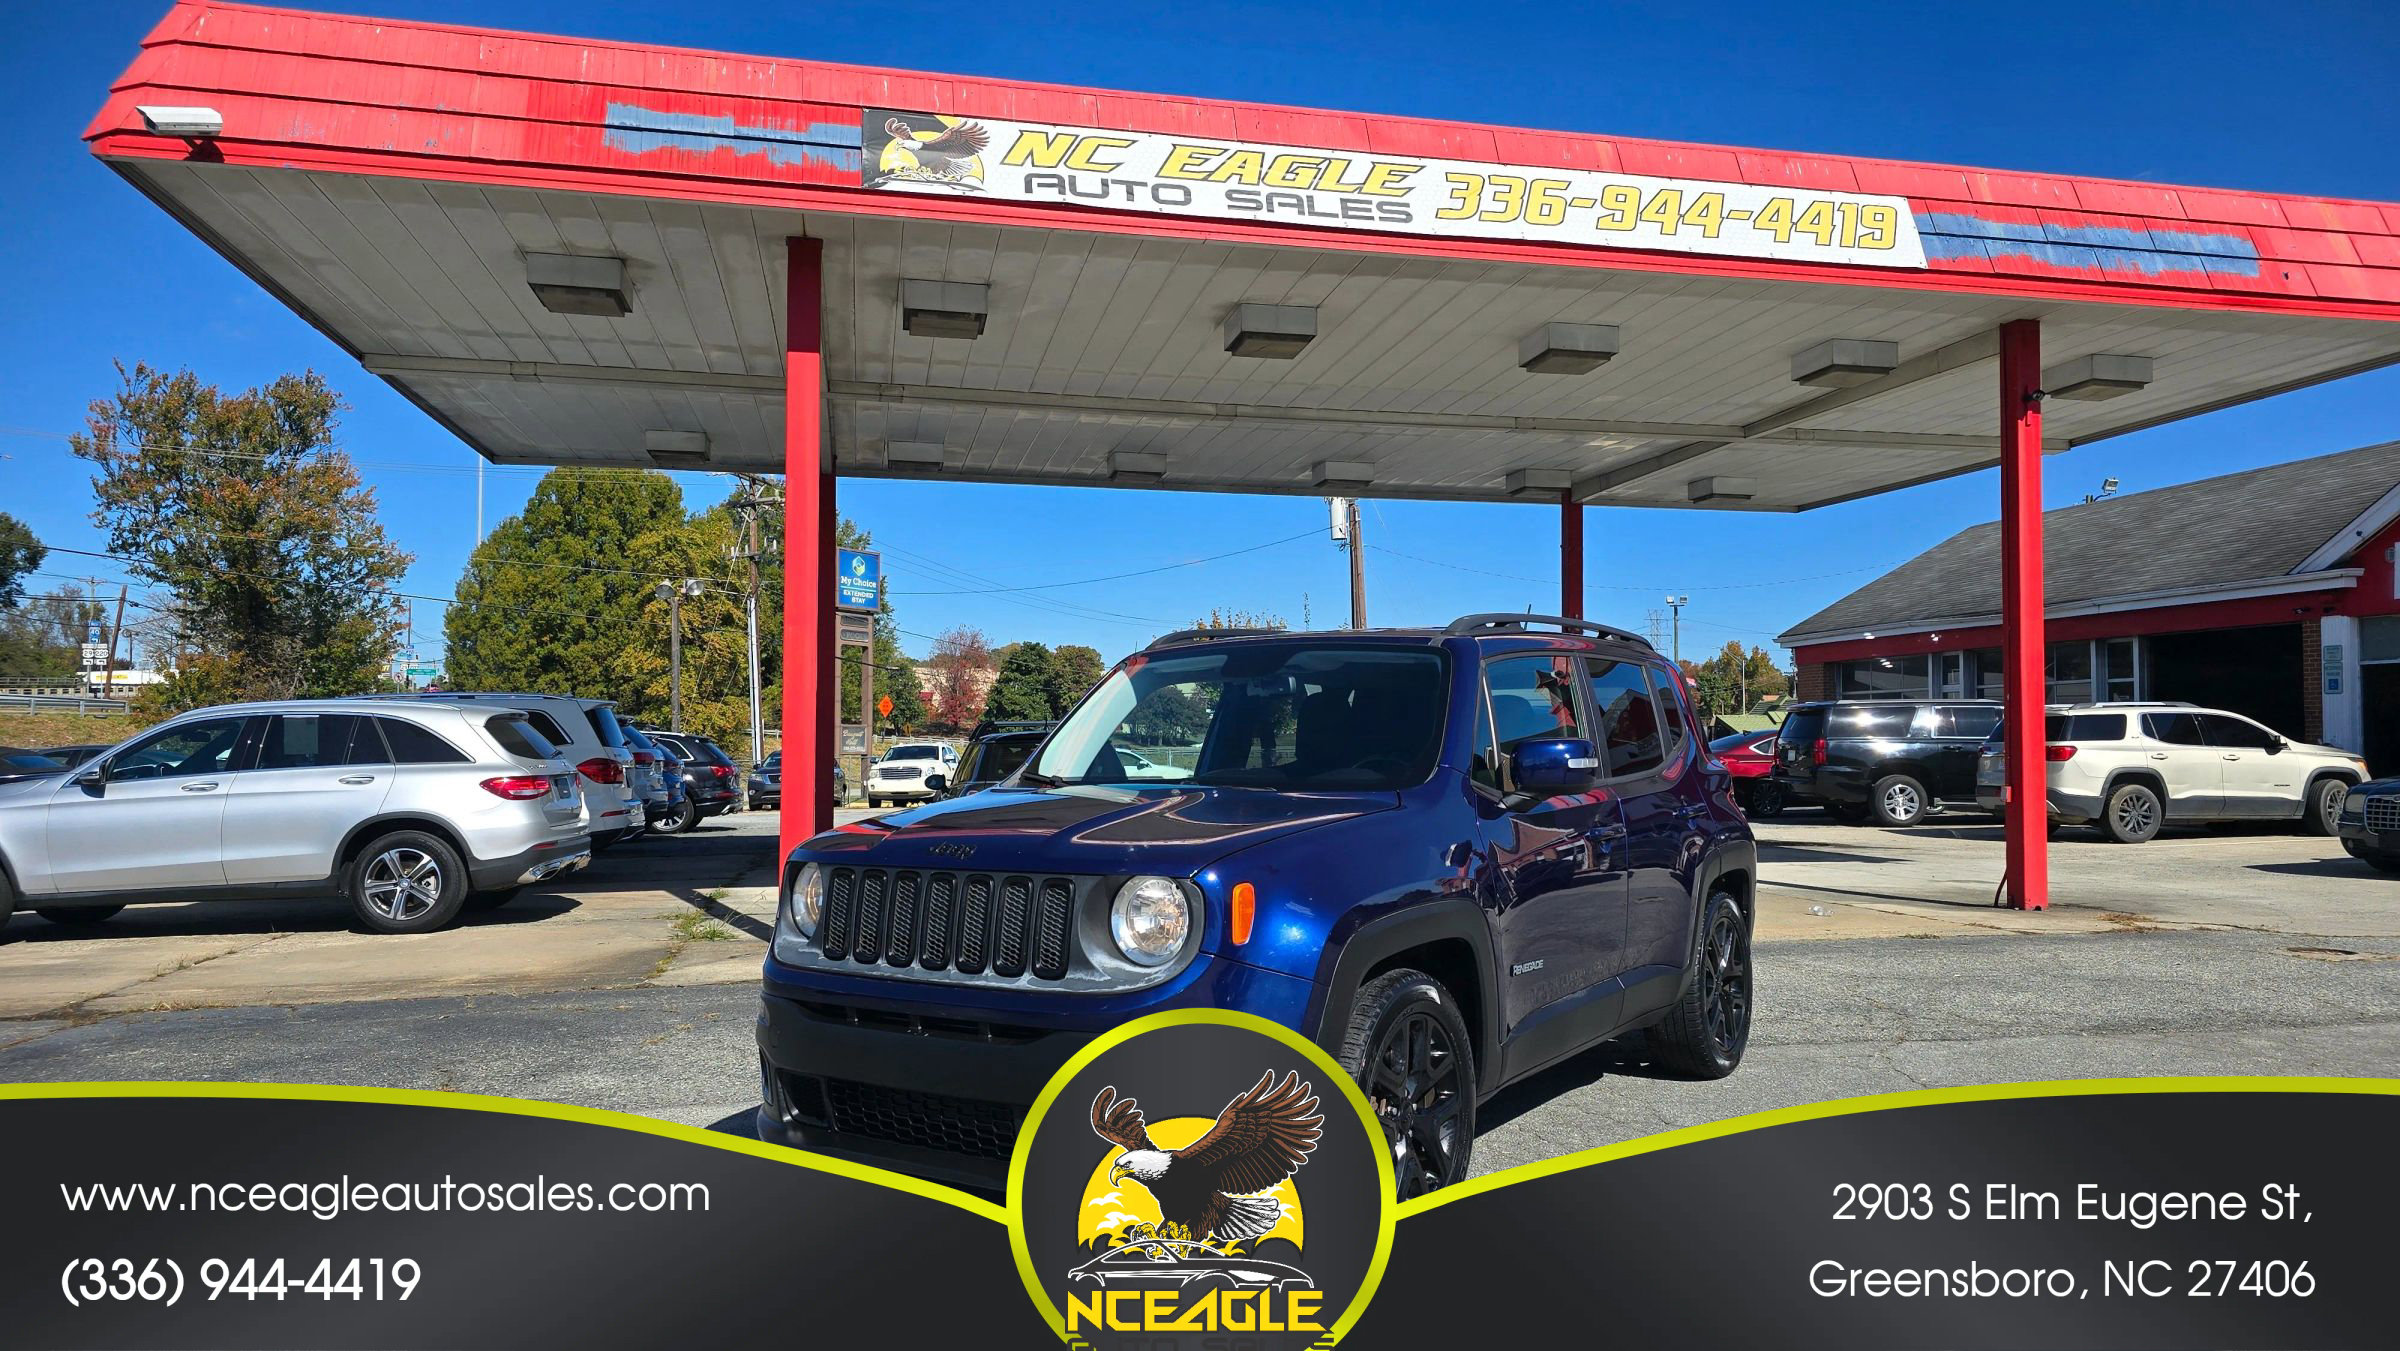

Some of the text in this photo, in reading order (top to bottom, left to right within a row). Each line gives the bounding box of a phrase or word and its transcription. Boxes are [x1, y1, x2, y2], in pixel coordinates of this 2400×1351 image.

[999, 129, 1898, 250] NC EAGLE 336-944-4419
[1024, 172, 1414, 223] AUTO SALES
[841, 575, 876, 587] My Choice
[843, 589, 874, 598] EXTENDED
[851, 597, 866, 605] STAY
[1512, 959, 1544, 977] RENEGADE
